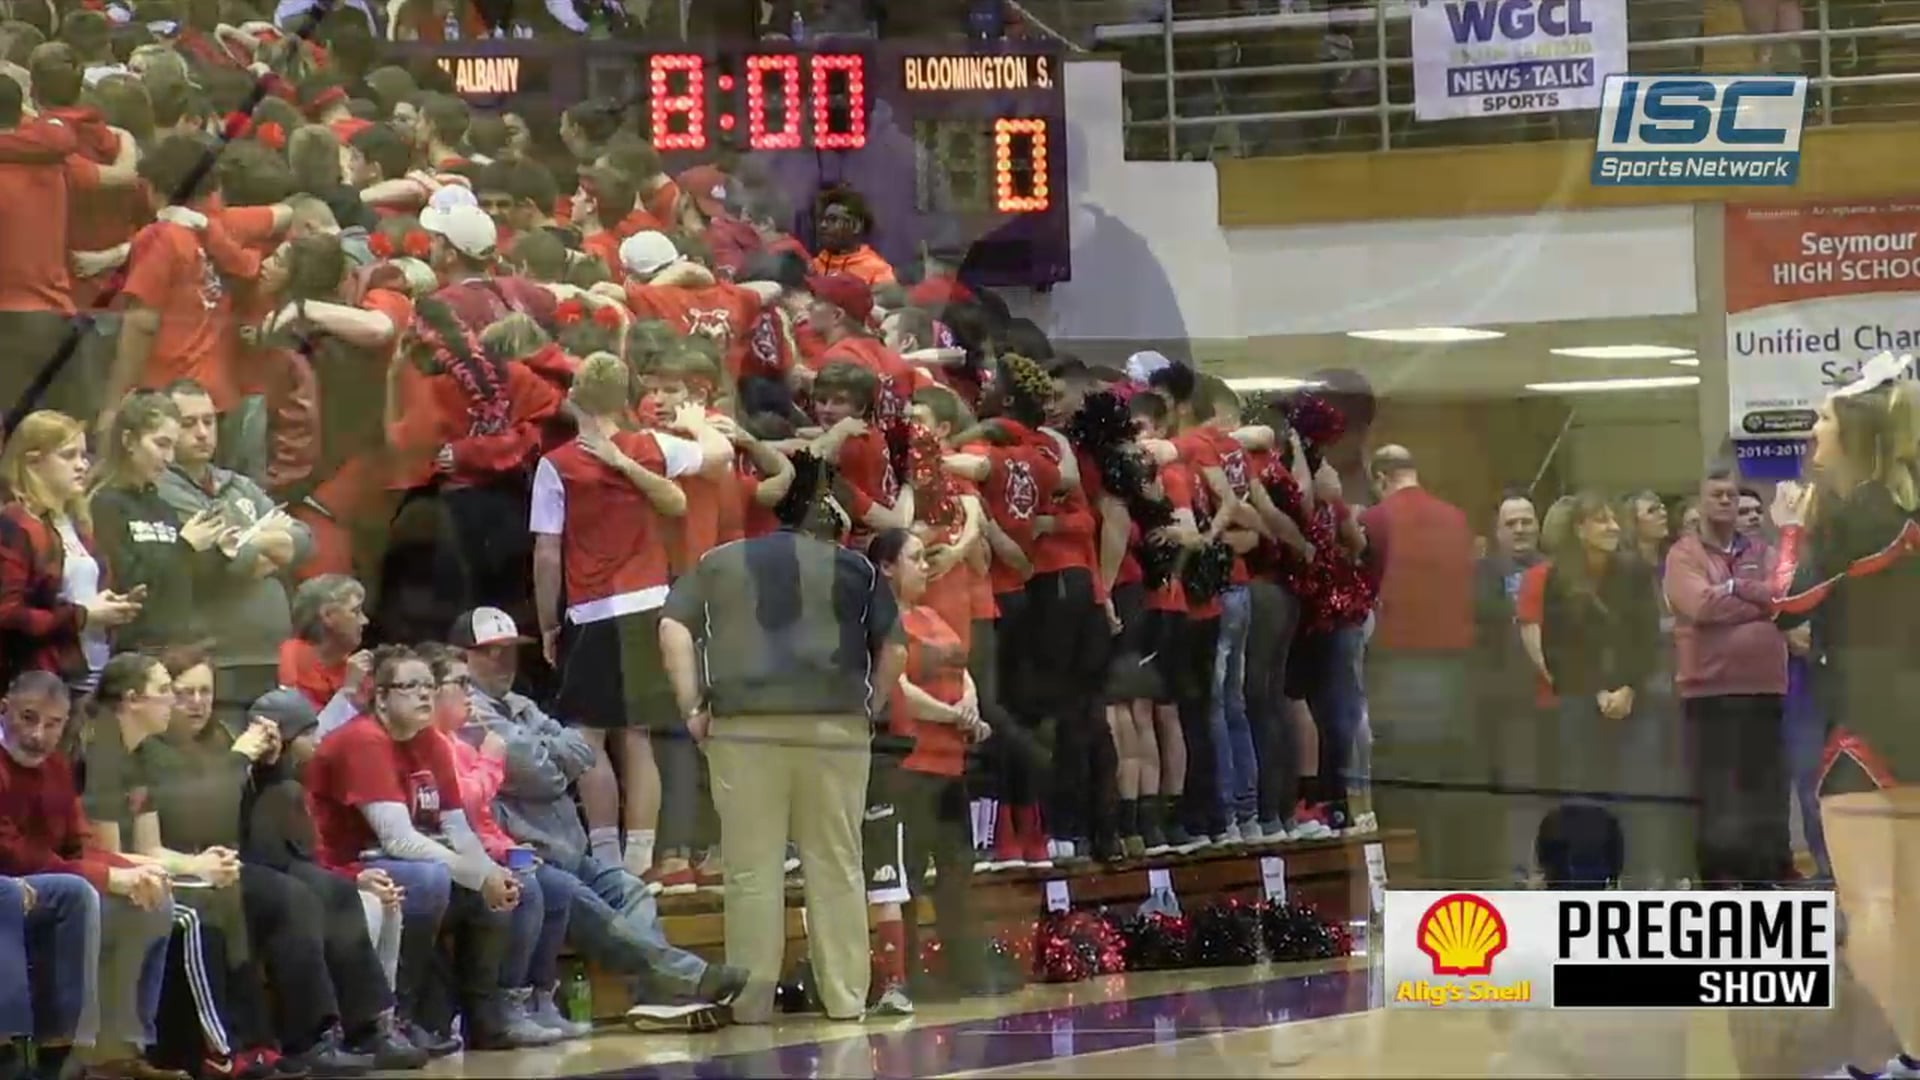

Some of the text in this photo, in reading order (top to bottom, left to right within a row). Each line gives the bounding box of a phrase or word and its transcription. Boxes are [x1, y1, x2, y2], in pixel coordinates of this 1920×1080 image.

[1445, 0, 1593, 44] WGCL
[456, 57, 518, 92] ALBANY
[905, 55, 1053, 90] BLOOMINGTON S.
[651, 55, 865, 149] 8:00
[1482, 92, 1559, 111] SPORTS
[995, 118, 1049, 211] 0
[1801, 231, 1917, 260] Seymour
[1773, 261, 1832, 285] HIGH
[1736, 328, 1840, 356] Unified
